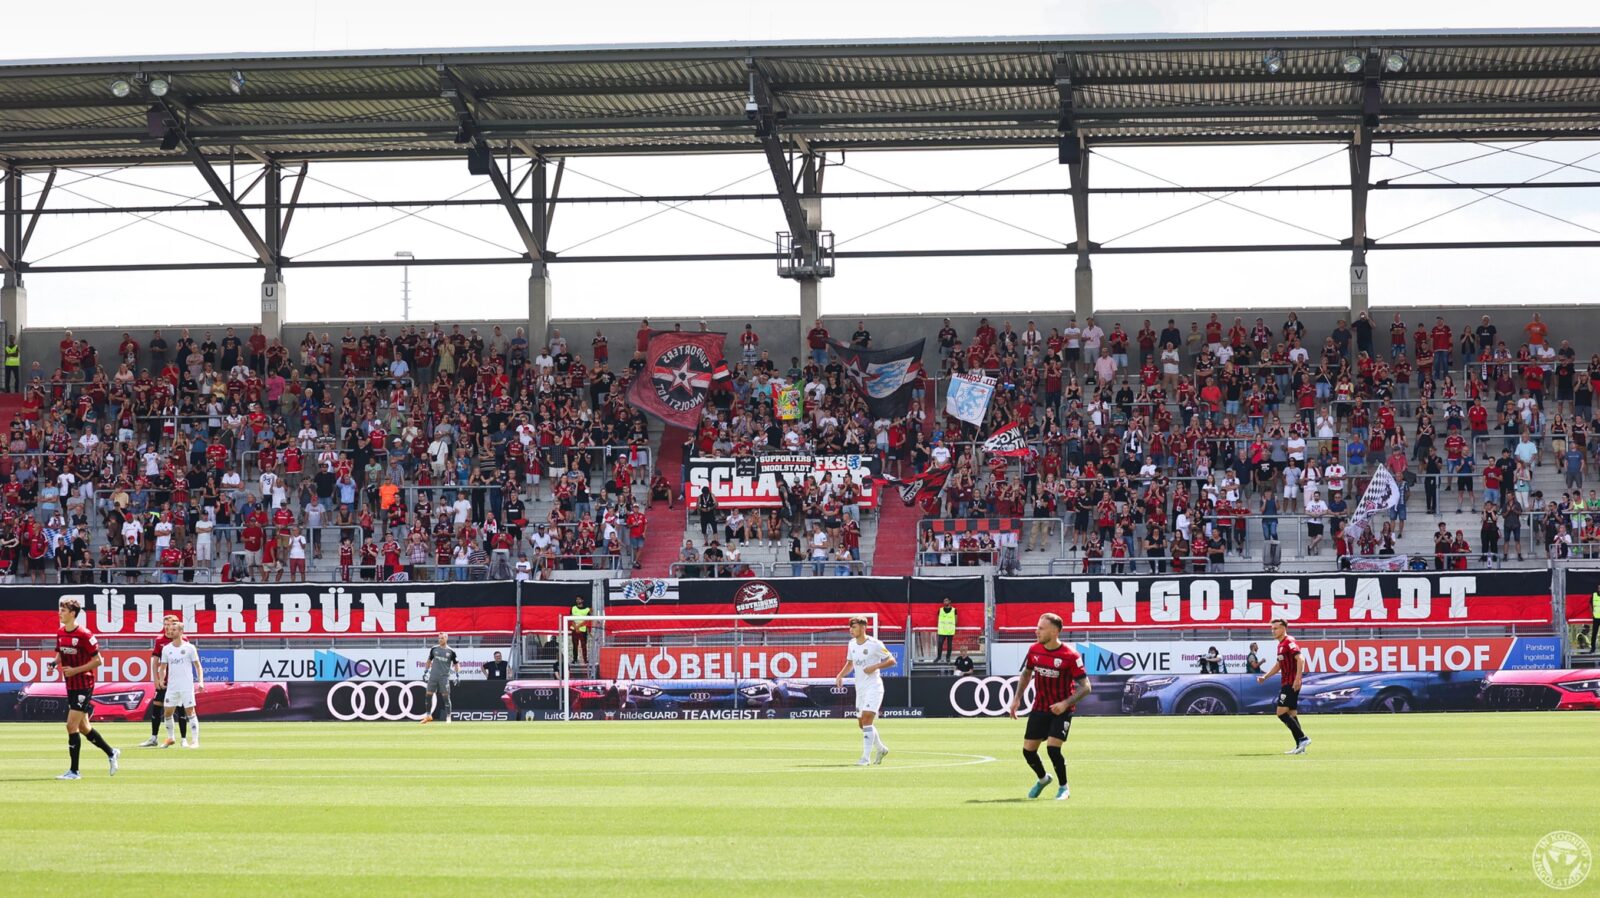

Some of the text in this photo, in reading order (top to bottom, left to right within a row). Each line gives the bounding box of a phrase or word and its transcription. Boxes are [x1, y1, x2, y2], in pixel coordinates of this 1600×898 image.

[1354, 269, 1364, 280] V
[265, 286, 274, 297] U
[760, 455, 811, 463] SUPPORTERS
[815, 456, 846, 470] FKS
[761, 465, 811, 473] INGOLSTADT
[1072, 577, 1477, 623] INGOLSTADT
[1526, 643, 1554, 651] Parsberg
[201, 656, 228, 664] Parsberg
[1097, 652, 1170, 671] MOVIE
[260, 659, 405, 678] AZUBI MOVIE
[619, 711, 678, 719] hildeGUARD
[682, 709, 761, 720] TEAMGEIST
[790, 709, 831, 719] guSTAFF
